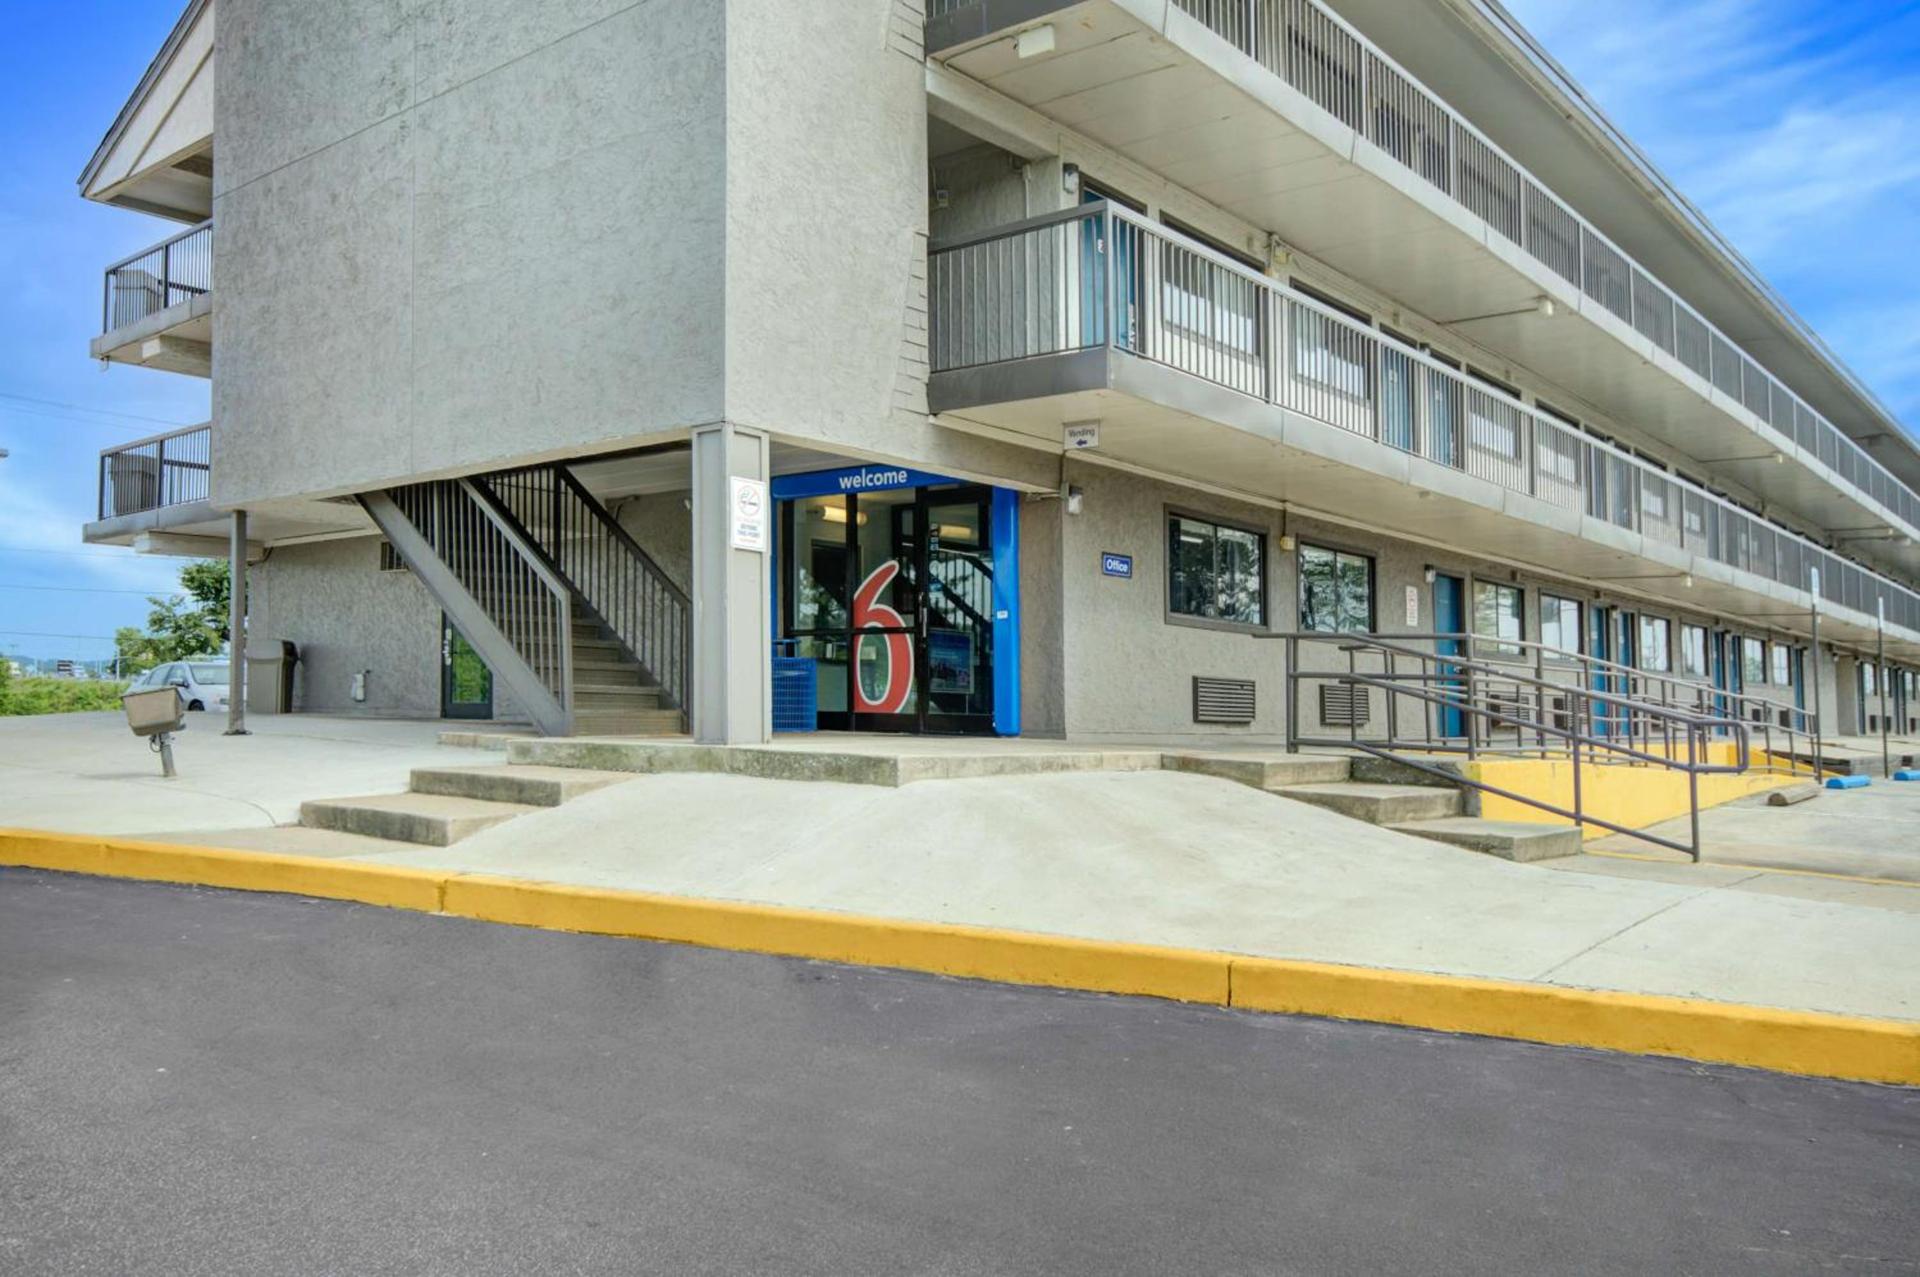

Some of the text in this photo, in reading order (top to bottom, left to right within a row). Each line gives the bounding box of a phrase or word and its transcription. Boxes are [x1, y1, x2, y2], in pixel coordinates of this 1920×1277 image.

[839, 467, 908, 489] welcome
[1106, 558, 1128, 573] Office
[854, 560, 914, 713] 6
